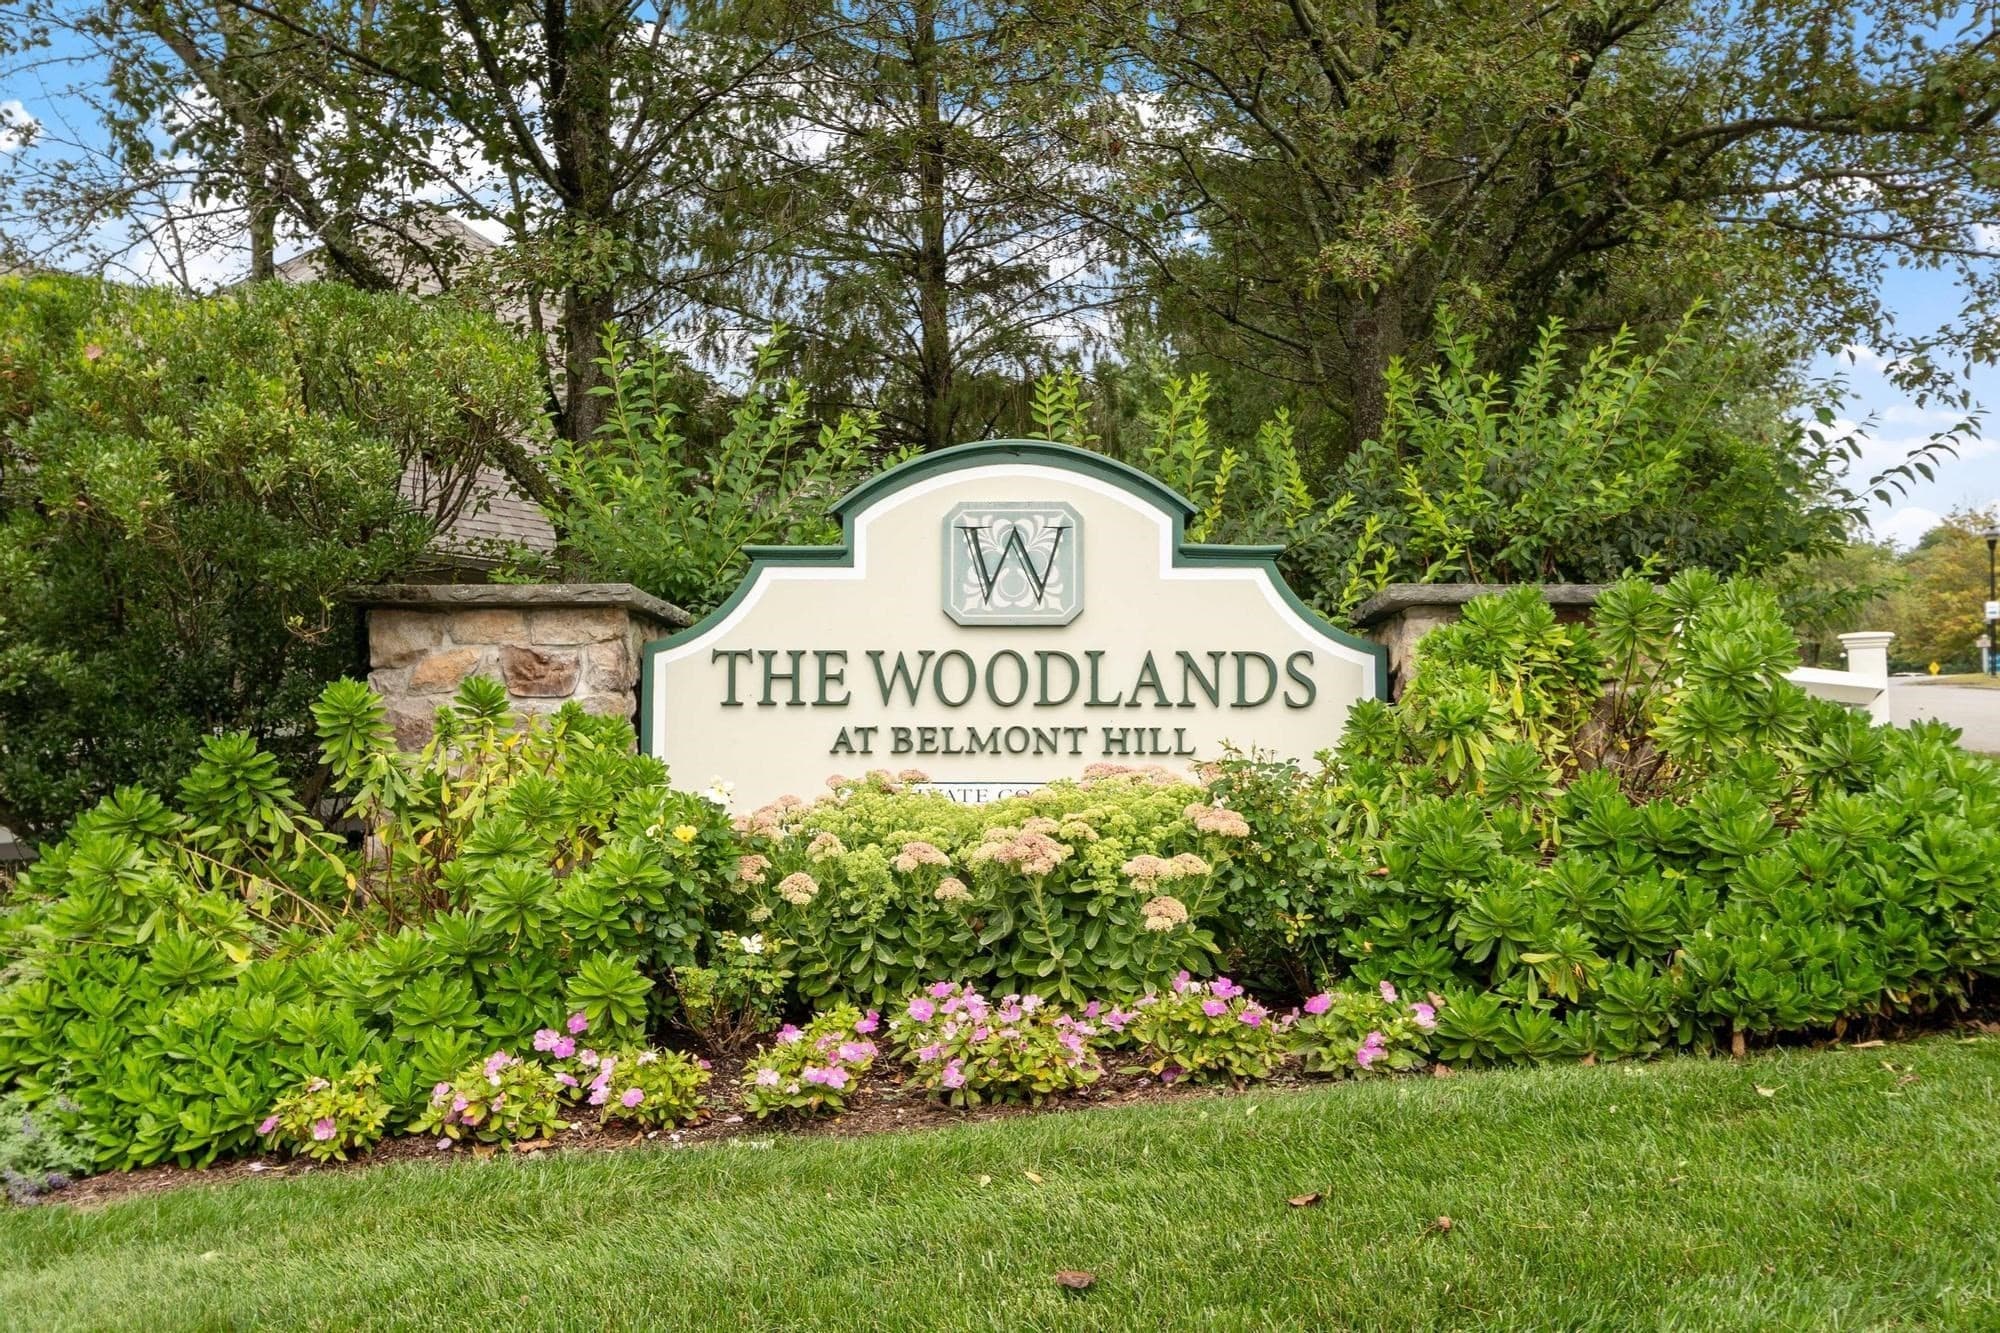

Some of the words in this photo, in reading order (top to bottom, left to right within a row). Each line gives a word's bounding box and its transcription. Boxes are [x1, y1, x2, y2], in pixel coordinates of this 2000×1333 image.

[953, 525, 1073, 605] W
[711, 648, 851, 708] THE
[865, 648, 1318, 709] WOODLANDS
[829, 725, 879, 755] AT
[890, 725, 1088, 755] BELMONT
[1101, 727, 1196, 756] HILL
